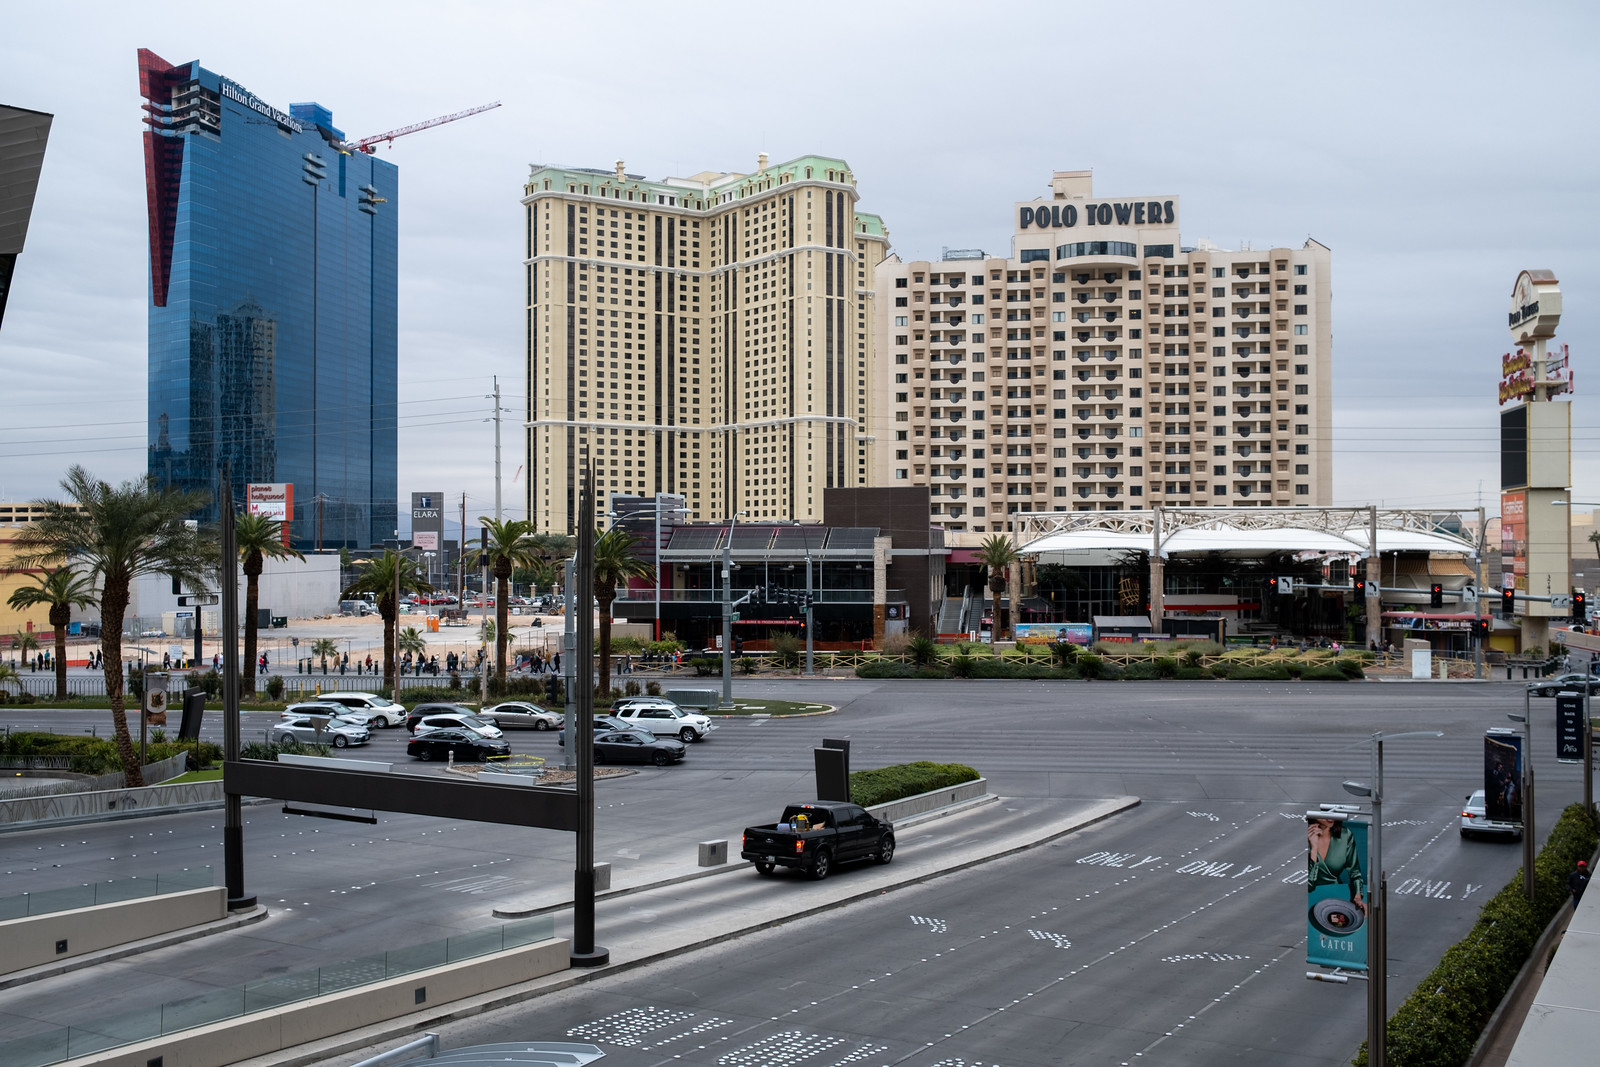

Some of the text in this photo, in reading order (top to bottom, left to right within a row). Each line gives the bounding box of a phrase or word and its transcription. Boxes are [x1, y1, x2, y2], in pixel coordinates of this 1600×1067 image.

[222, 83, 303, 134] Hilton Grand Vacations
[1020, 200, 1175, 229] POLO TOWERS
[251, 493, 285, 501] hollywood
[413, 510, 438, 518] ELARA
[1076, 851, 1162, 869] ONLY
[1176, 860, 1262, 879] ONLY
[1395, 878, 1483, 900] ONLY
[1320, 938, 1354, 951] CATCH
